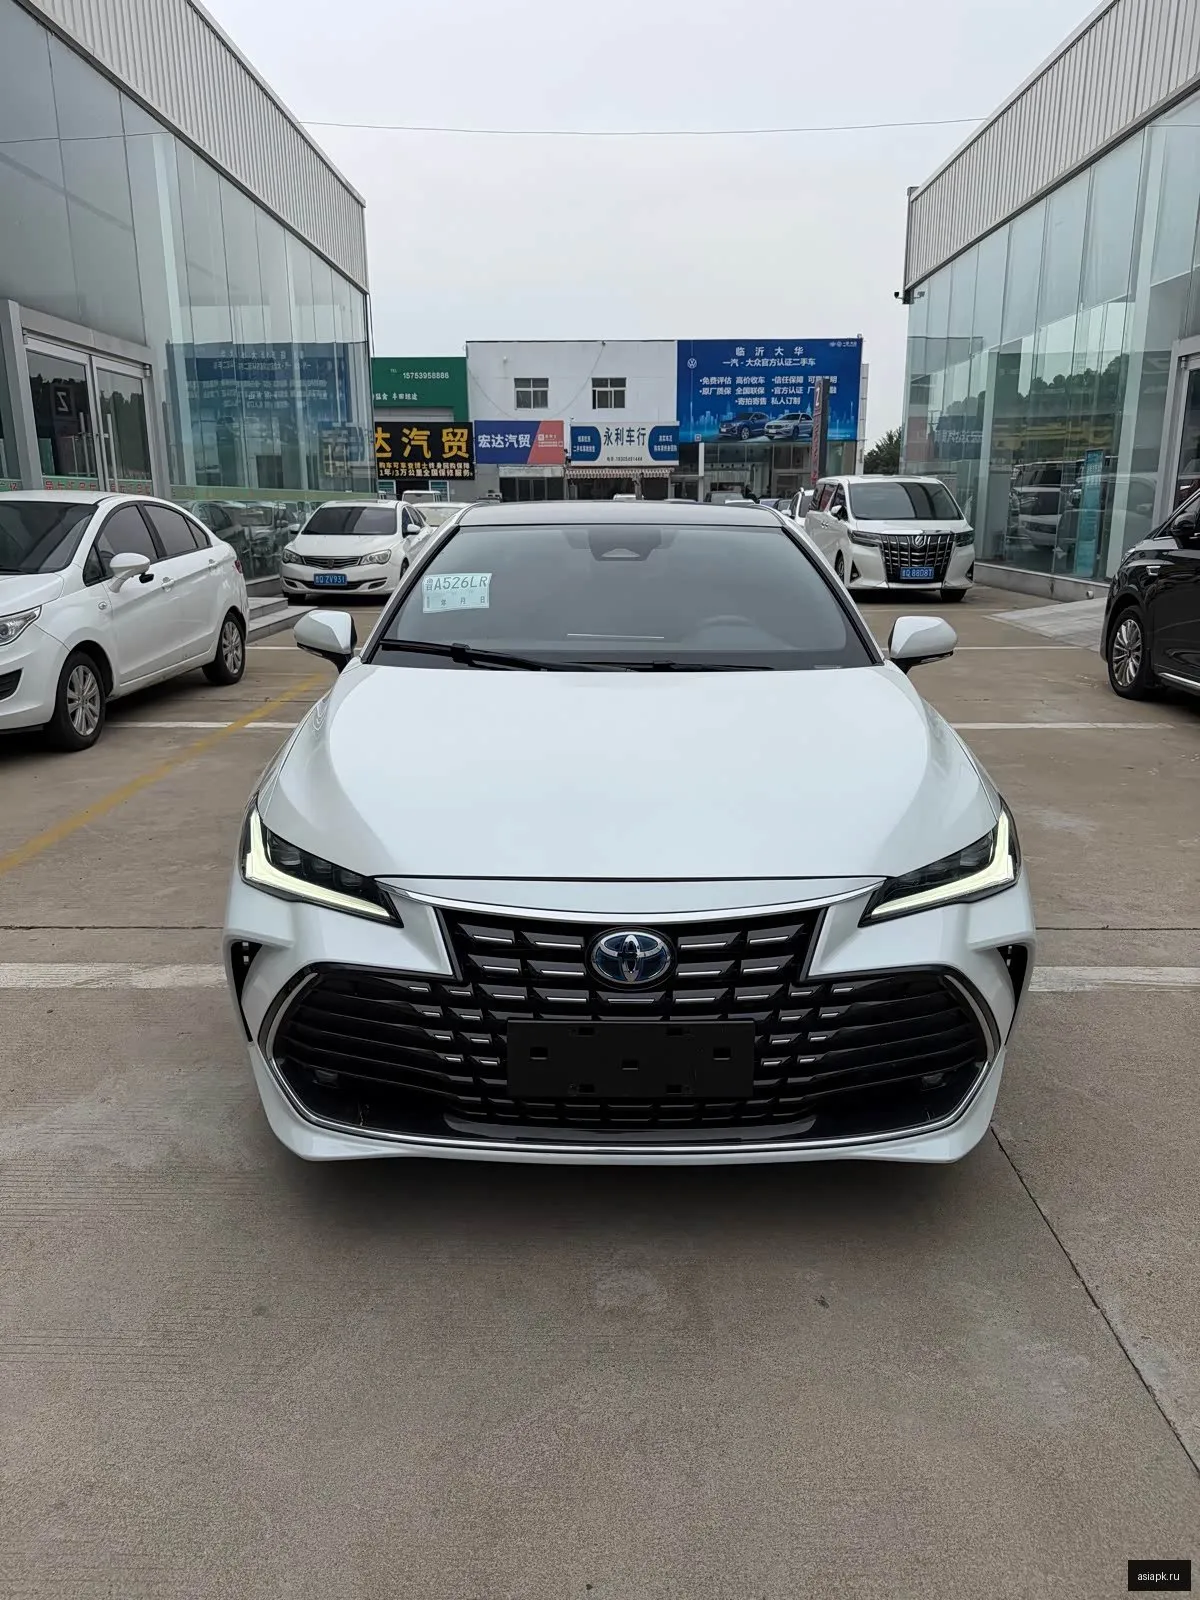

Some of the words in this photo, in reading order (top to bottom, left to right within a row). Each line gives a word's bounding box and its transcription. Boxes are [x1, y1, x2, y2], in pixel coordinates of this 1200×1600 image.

[735, 347, 804, 356] 临沂大华
[807, 375, 837, 384] 可明
[478, 433, 531, 448] 宏达汽贸
[603, 427, 646, 446] 永利车行
